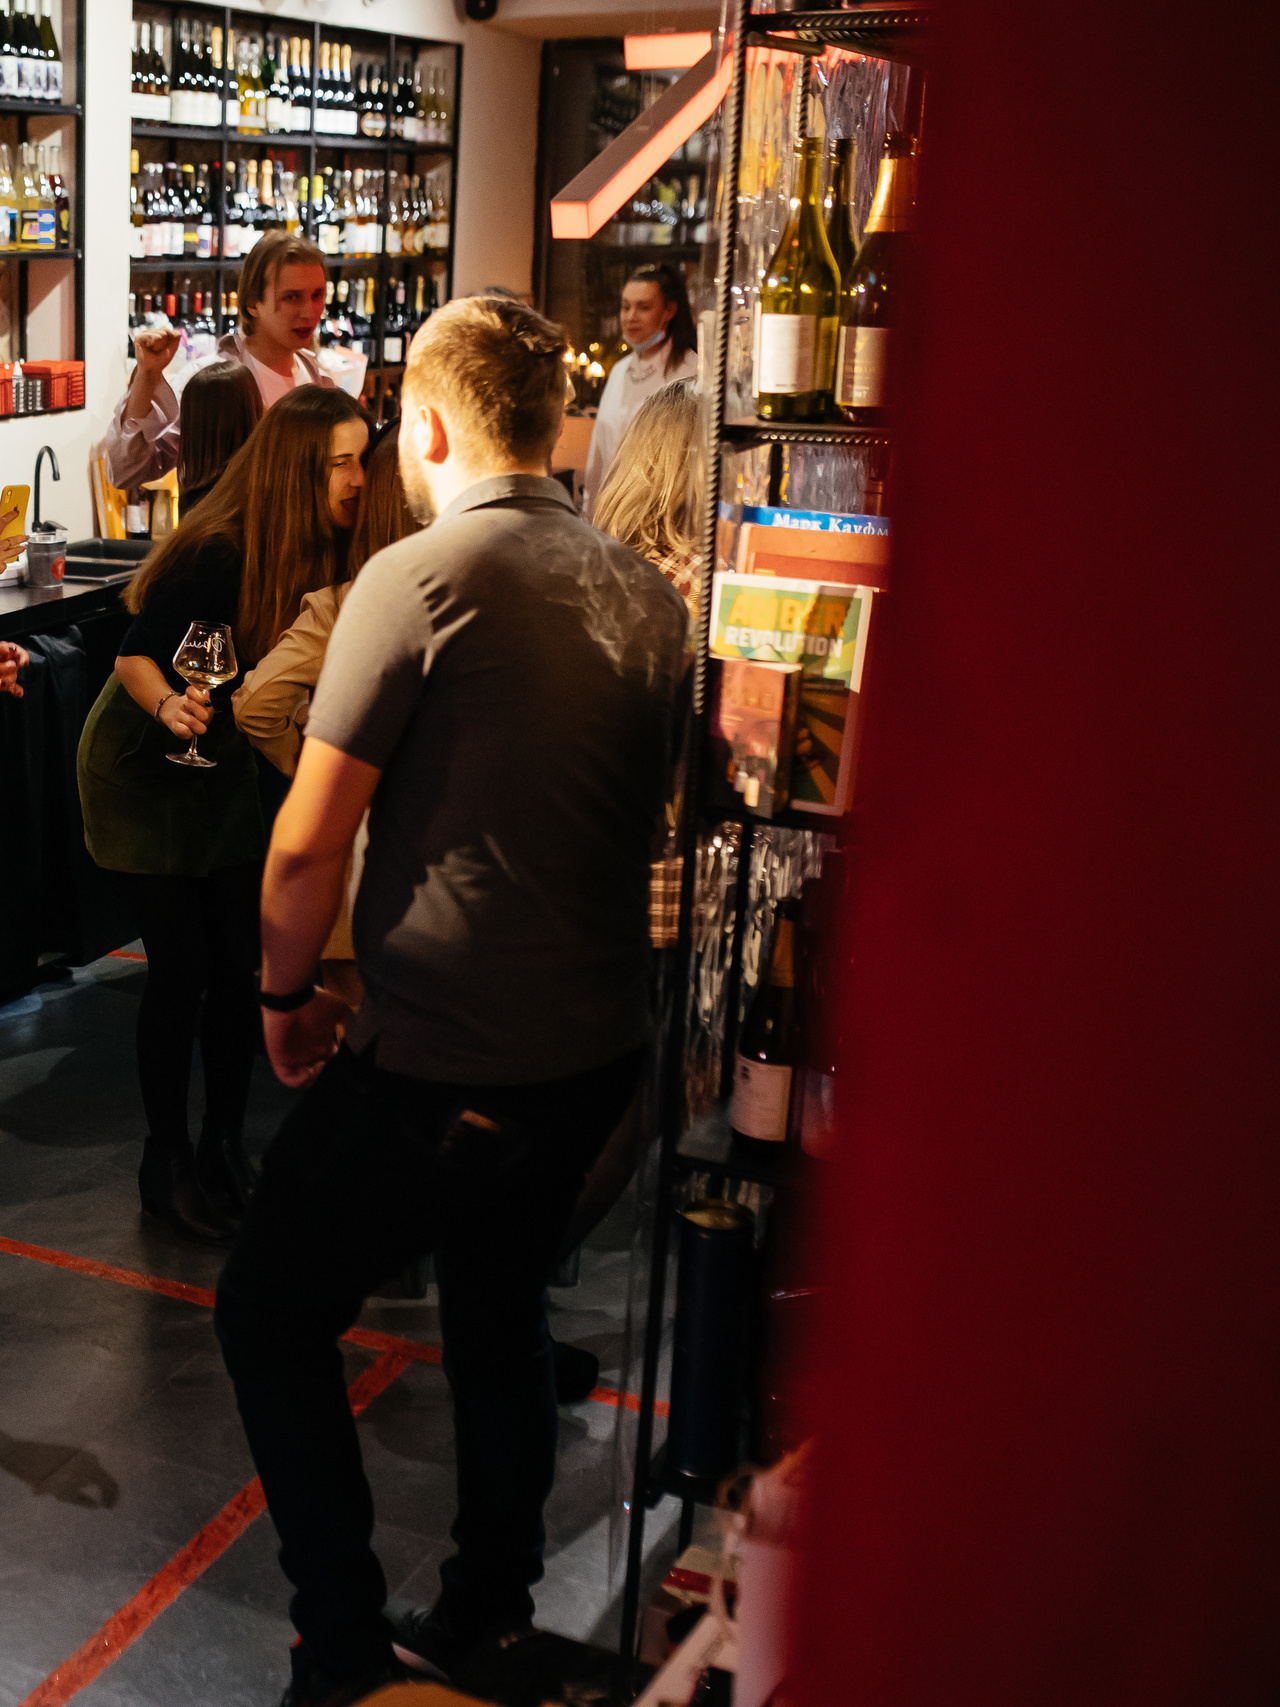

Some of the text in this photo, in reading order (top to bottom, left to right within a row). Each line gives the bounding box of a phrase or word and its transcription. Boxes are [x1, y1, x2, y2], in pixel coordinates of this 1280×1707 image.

[772, 513, 822, 530] Марк
[727, 593, 844, 637] AMBER
[724, 625, 843, 658] REVOLUTION
